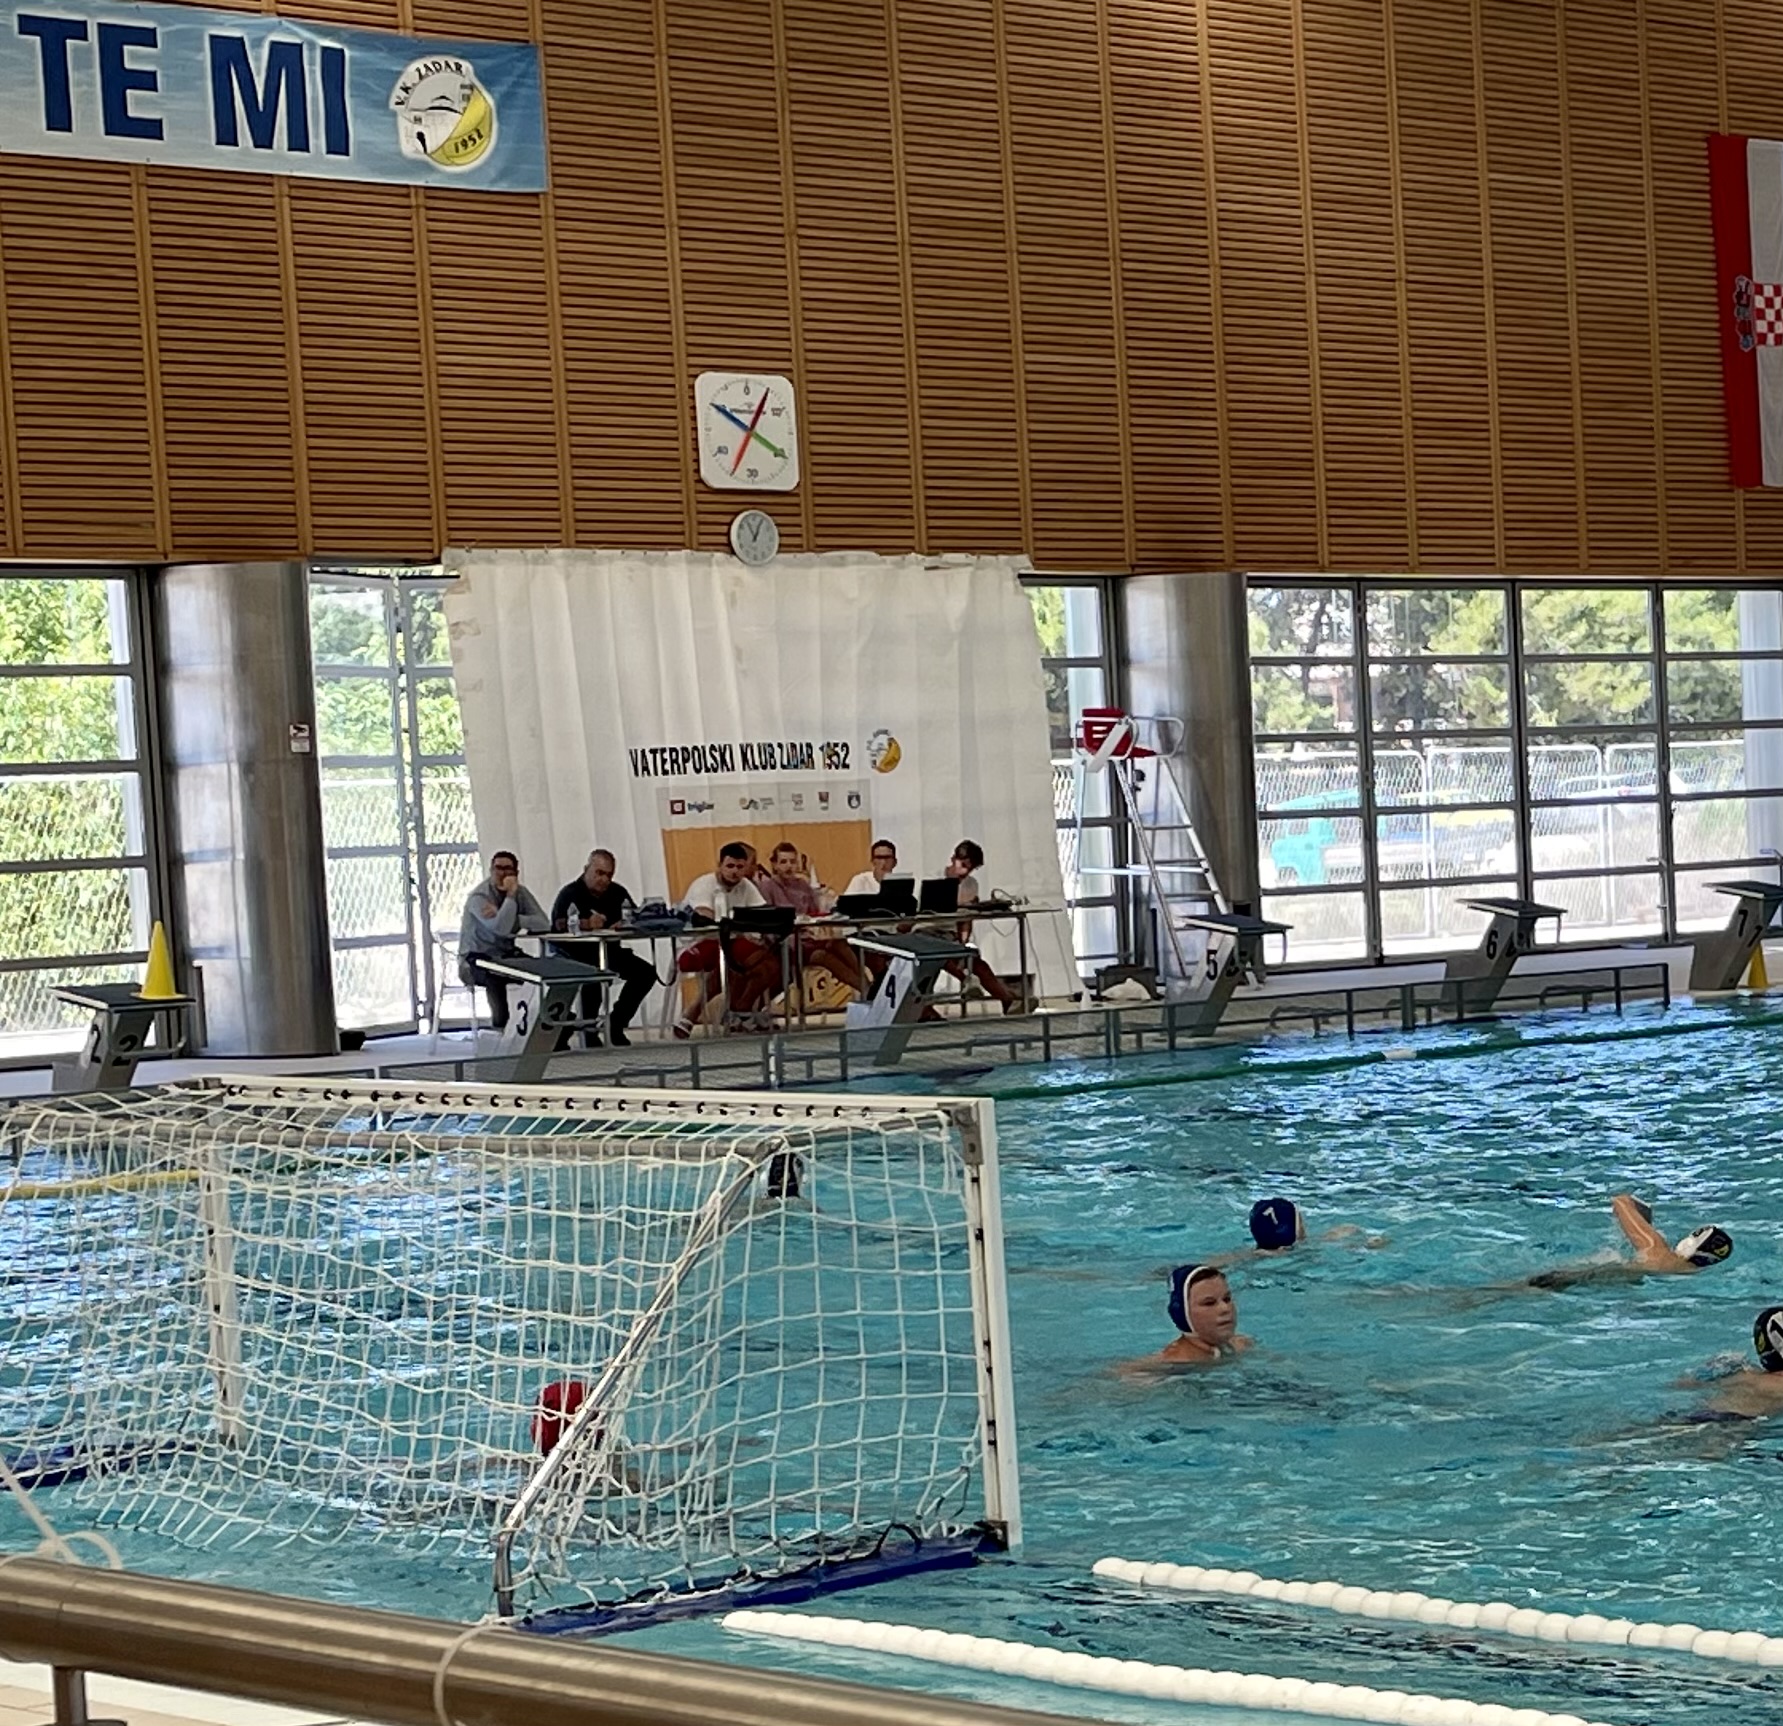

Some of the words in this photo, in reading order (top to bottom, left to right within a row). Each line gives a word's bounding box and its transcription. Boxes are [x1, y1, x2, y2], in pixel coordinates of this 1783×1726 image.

[17, 14, 165, 141] TE
[208, 34, 350, 157] MI
[416, 60, 465, 80] ZADAR
[454, 128, 484, 154] 1952
[629, 743, 735, 777] VATERPOLSKI
[739, 741, 777, 771] KLUB
[1738, 909, 1748, 938] 7
[1486, 929, 1499, 960] 6
[1206, 949, 1218, 981] 5
[885, 974, 896, 1009] 4
[516, 1000, 528, 1036] 3
[91, 1023, 102, 1064] 2
